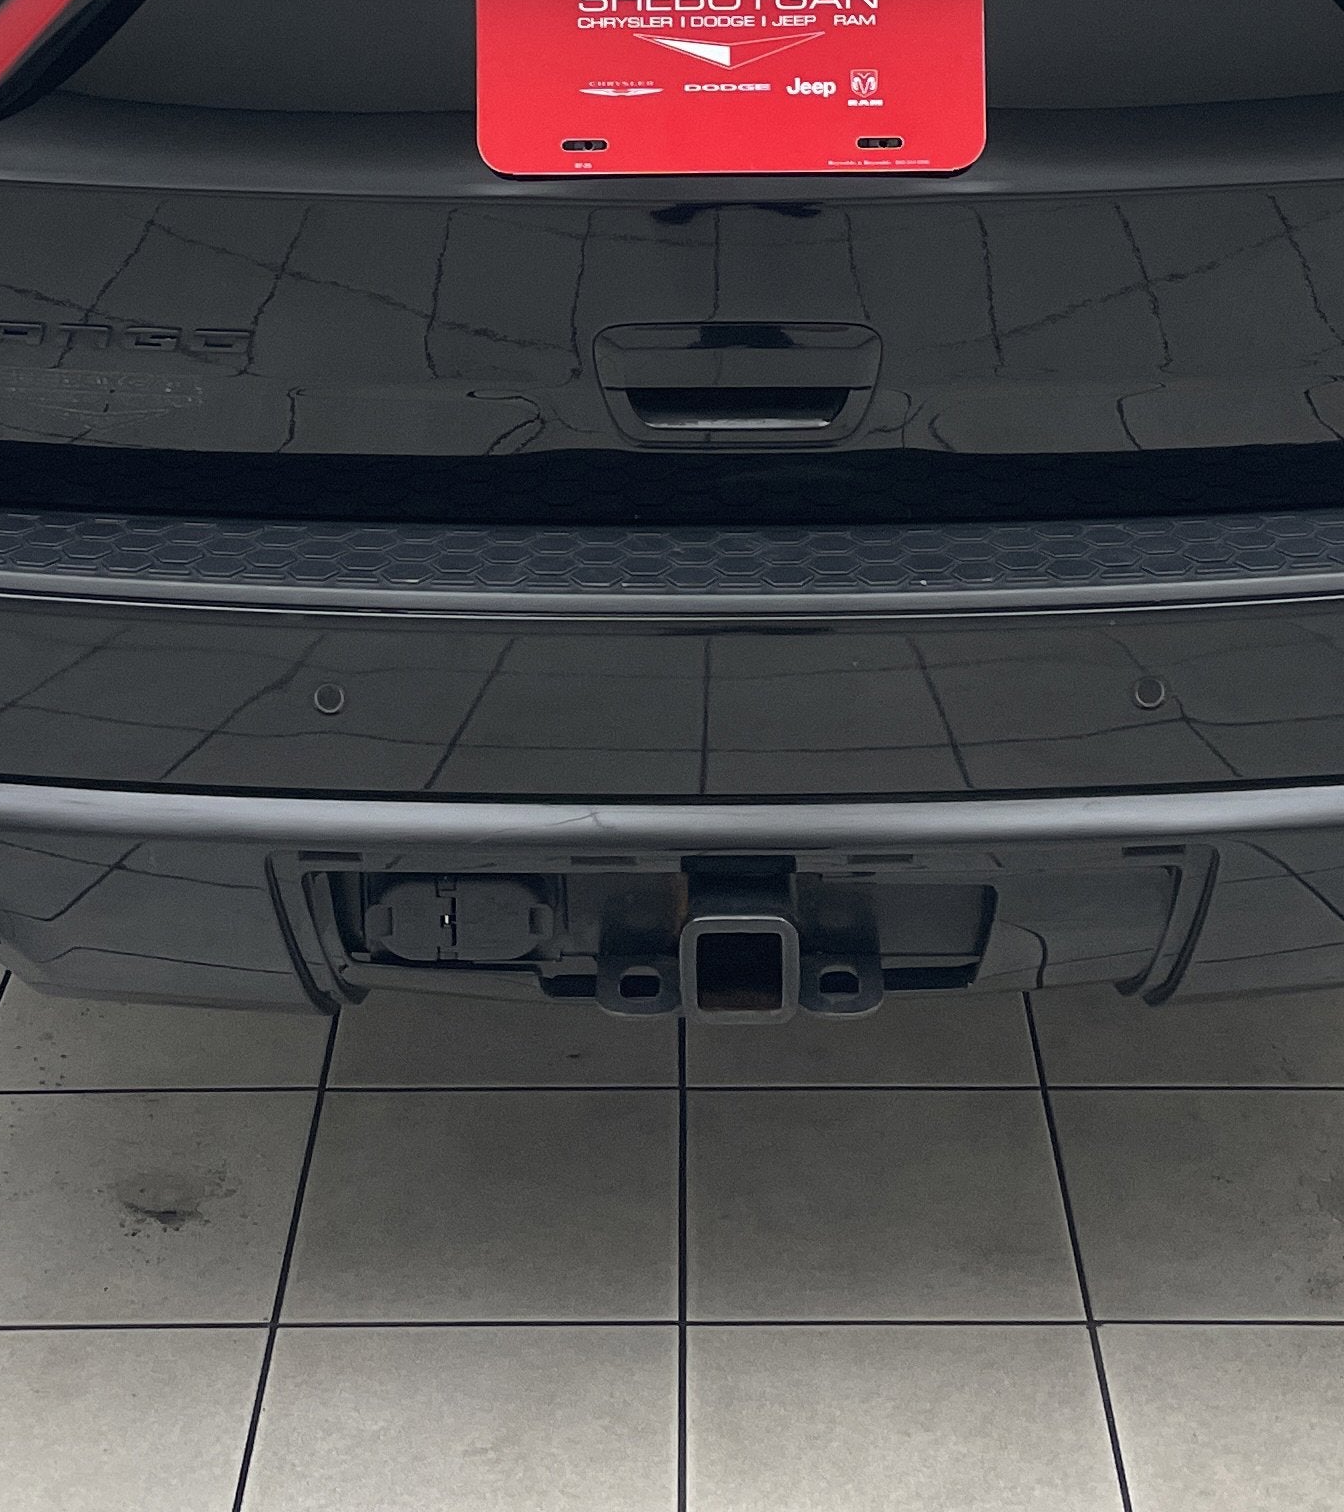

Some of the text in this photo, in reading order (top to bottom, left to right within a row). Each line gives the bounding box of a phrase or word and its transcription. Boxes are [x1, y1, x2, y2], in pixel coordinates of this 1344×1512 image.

[577, 14, 877, 29] CHRYSLER DODGE JEEP RAM
[683, 83, 772, 92] DODGE
[785, 76, 837, 98] Jeep
[847, 99, 884, 107] RAM
